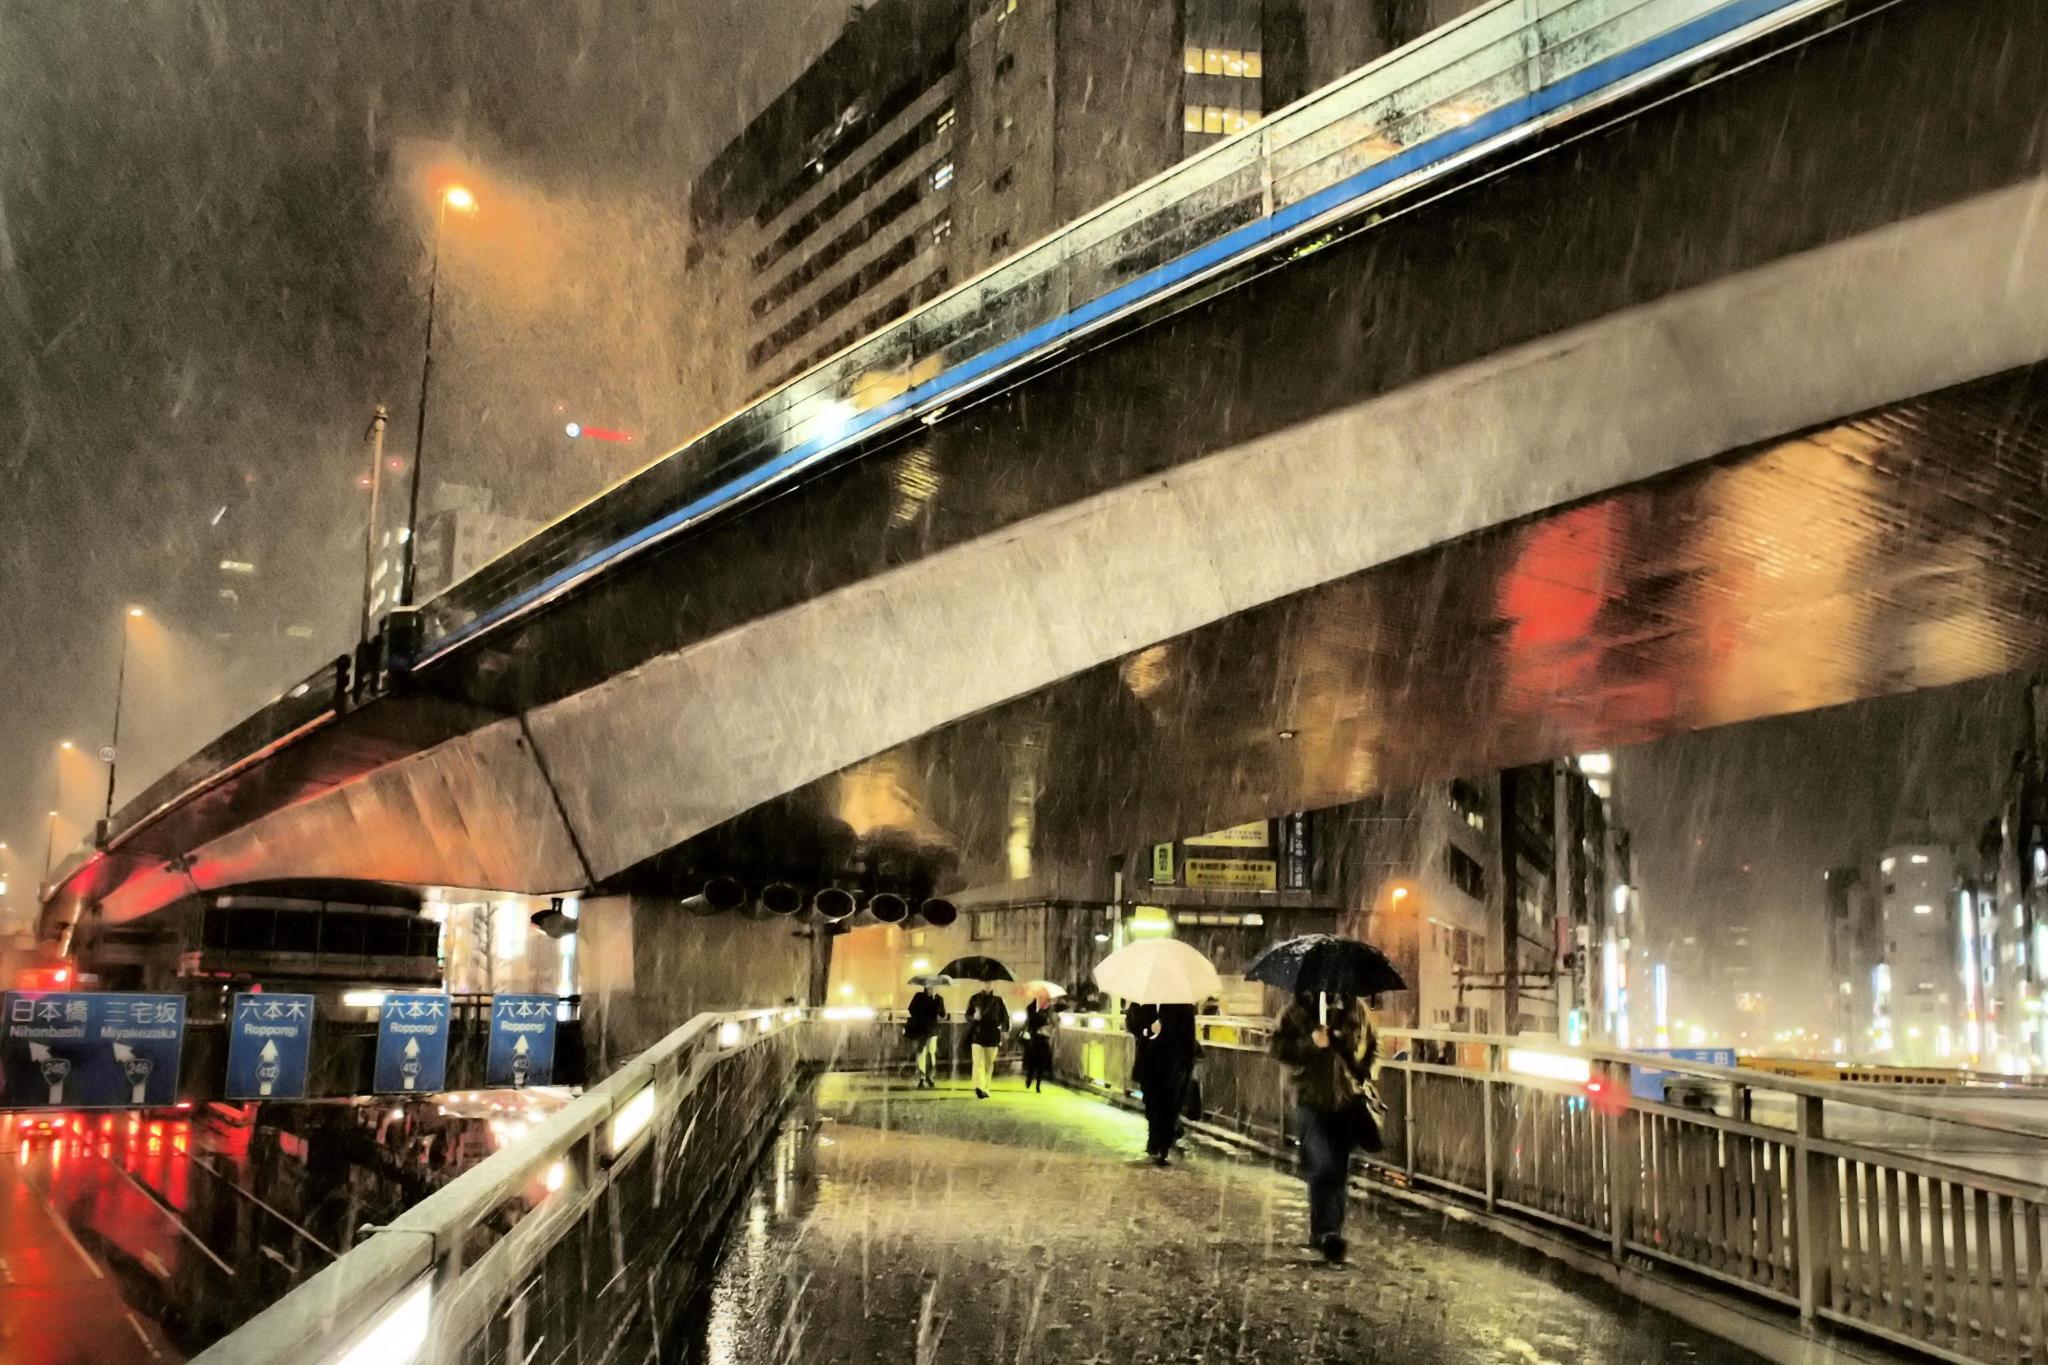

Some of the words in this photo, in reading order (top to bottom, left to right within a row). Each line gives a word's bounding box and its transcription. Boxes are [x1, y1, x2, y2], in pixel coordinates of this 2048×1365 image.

[11, 999, 89, 1023] 日本橋
[103, 1001, 178, 1024] 三宅坂
[239, 1000, 307, 1021] 六本木
[386, 1000, 444, 1019] 六本木
[496, 1000, 552, 1019] 六本木
[10, 1025, 86, 1038] Nihonbashi
[101, 1026, 178, 1040] Miyakezaka
[244, 1023, 299, 1037] Roppongi
[390, 1022, 438, 1035] Roppongi
[501, 1020, 546, 1034] Roppongi
[46, 1062, 67, 1075] 246
[127, 1062, 149, 1075] 246
[260, 1066, 277, 1078] 412
[403, 1062, 419, 1073] 412
